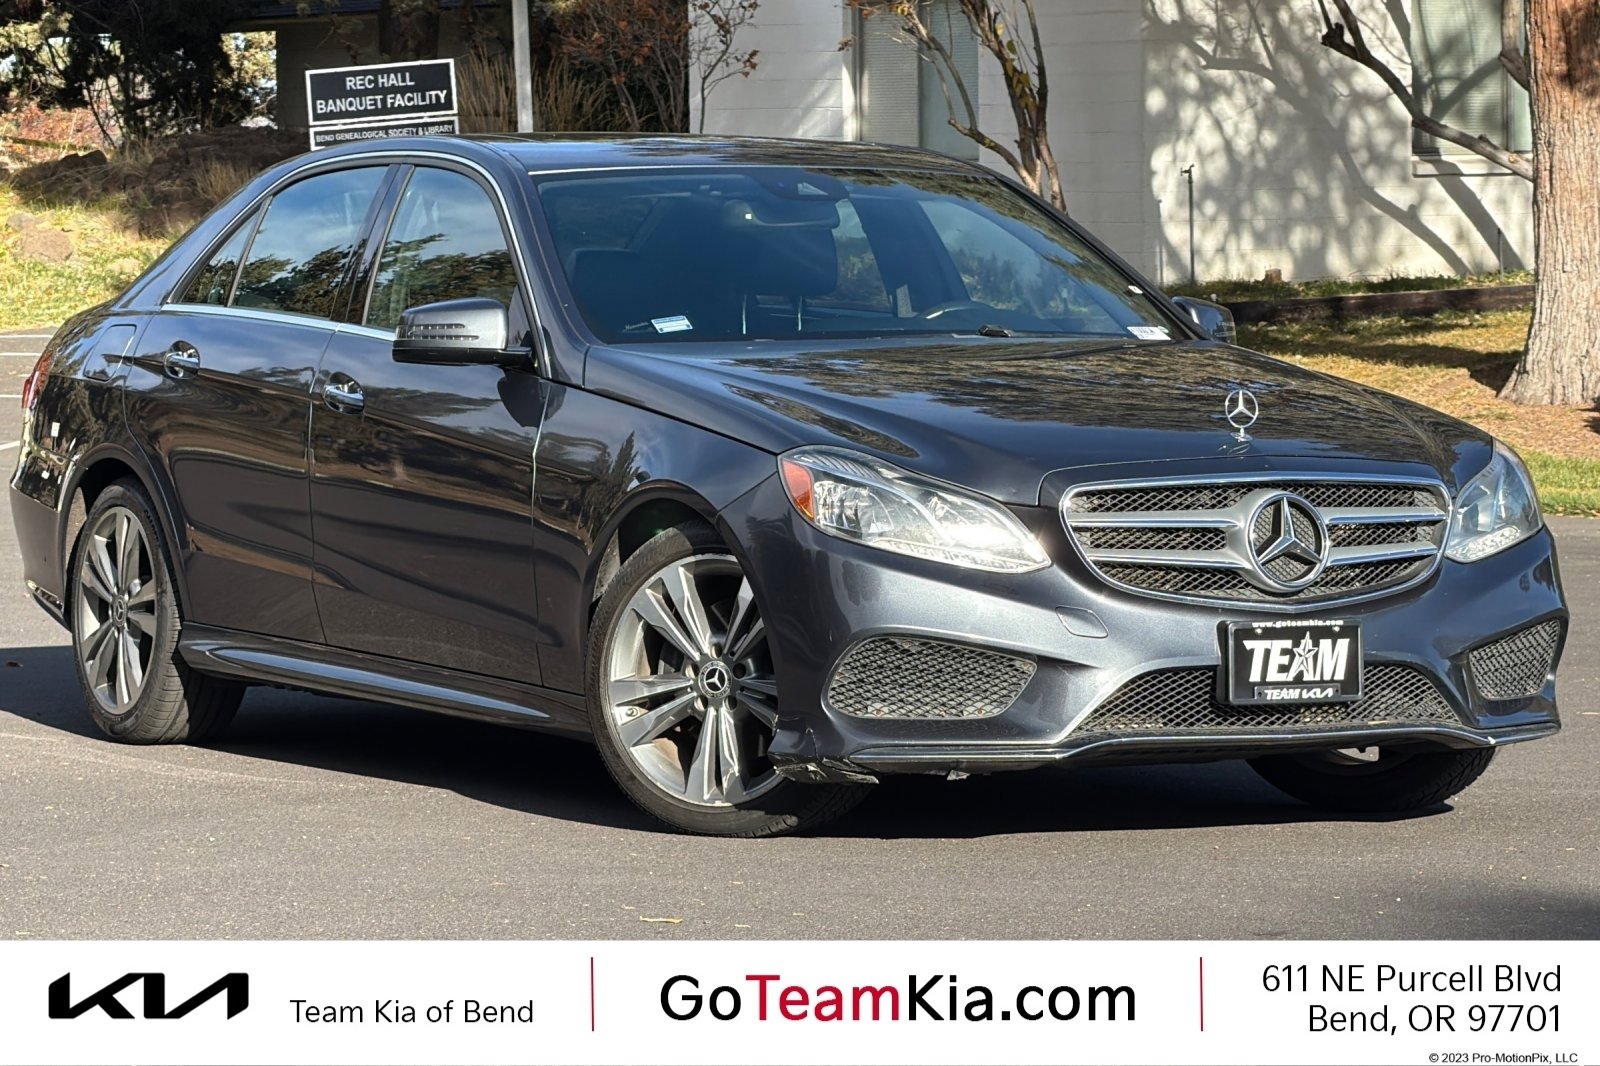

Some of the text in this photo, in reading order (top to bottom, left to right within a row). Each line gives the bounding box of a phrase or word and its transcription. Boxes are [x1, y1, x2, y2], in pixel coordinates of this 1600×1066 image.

[345, 72, 415, 91] REC HALL
[316, 90, 448, 114] BANQUET FACILITY
[315, 124, 453, 143] BEND GENEALOGICAL SOCIETY & LIBRARY
[1242, 634, 1350, 682] TEAM
[1264, 688, 1300, 700] TEAM
